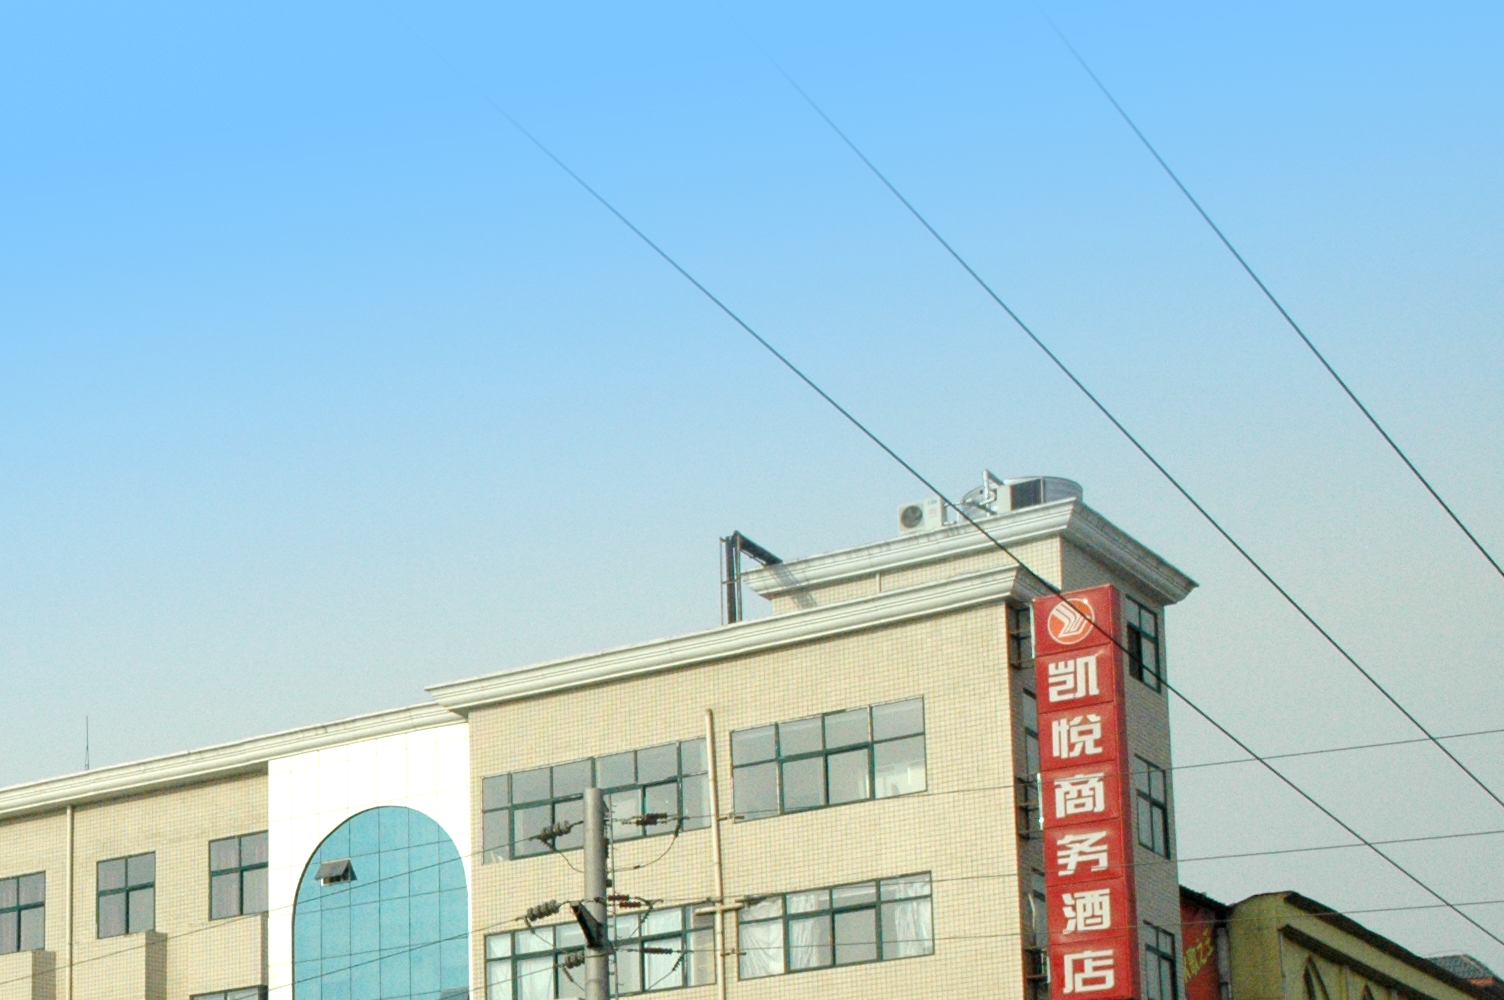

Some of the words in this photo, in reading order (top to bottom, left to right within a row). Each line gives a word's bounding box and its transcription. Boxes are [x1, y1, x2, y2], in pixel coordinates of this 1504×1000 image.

[1047, 655, 1116, 996] 凯悦商务酒店
